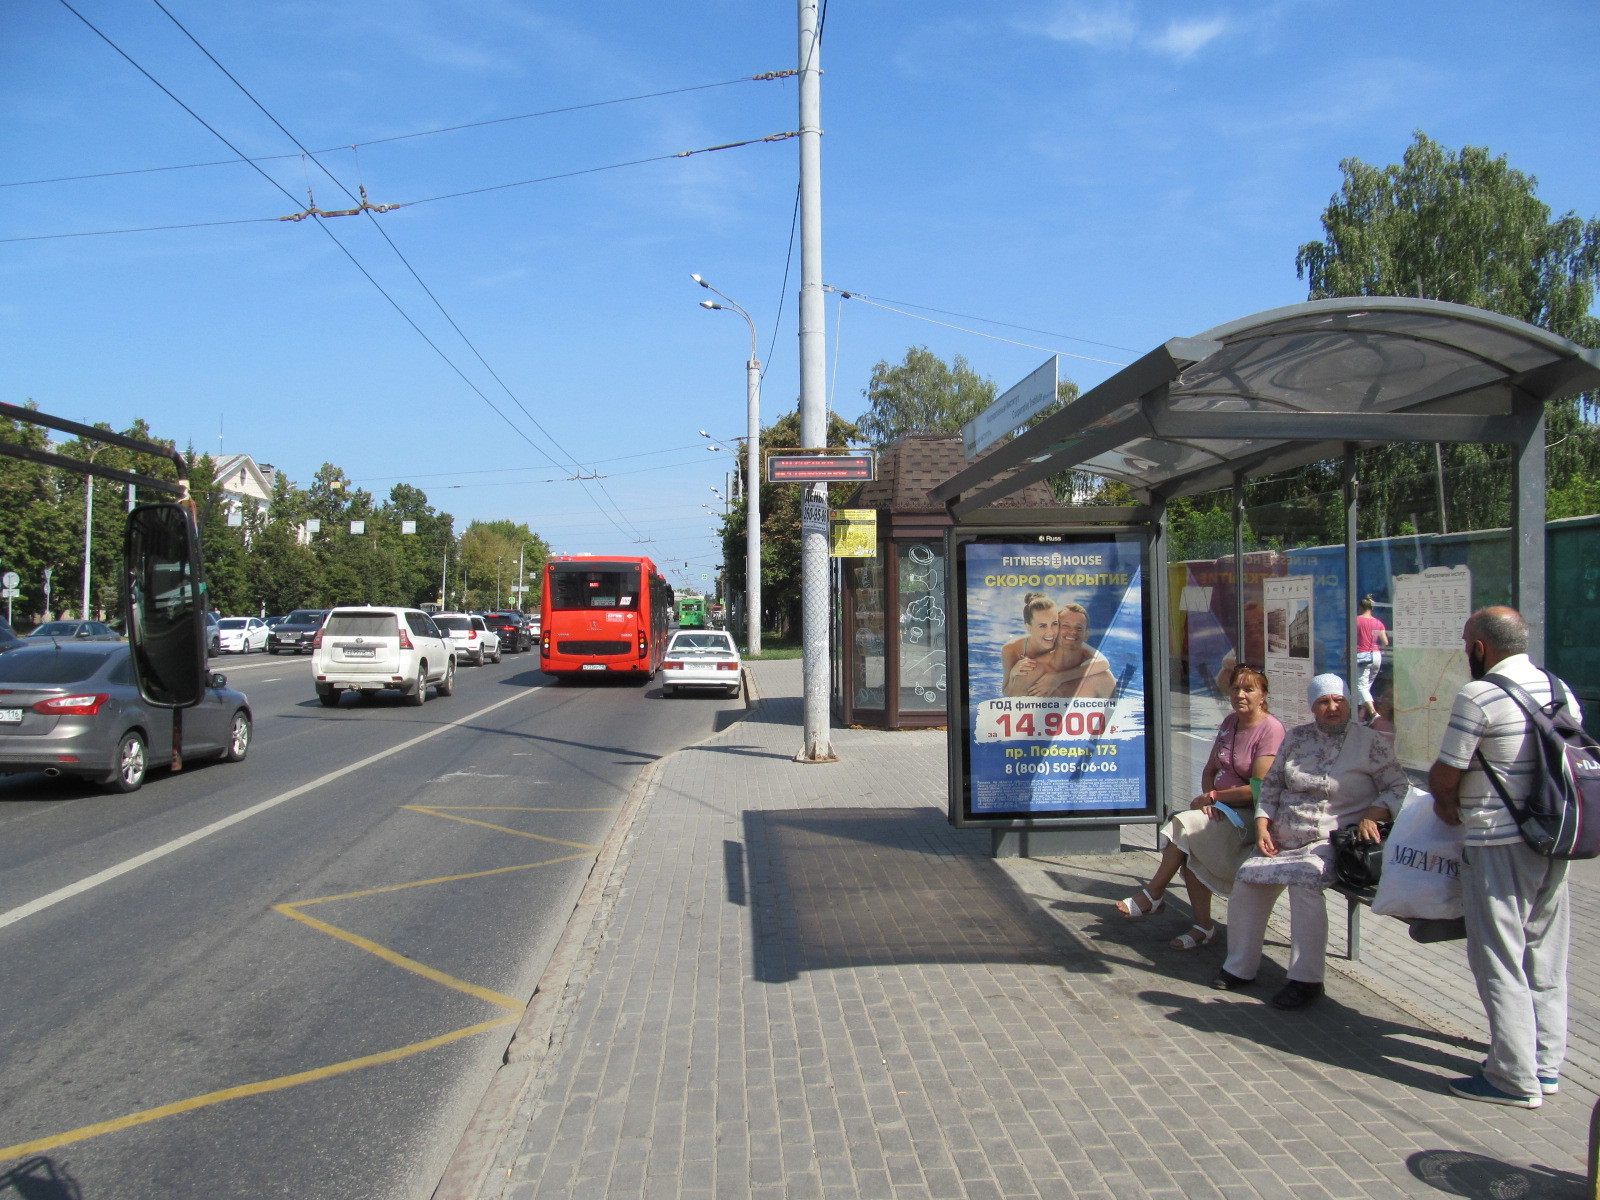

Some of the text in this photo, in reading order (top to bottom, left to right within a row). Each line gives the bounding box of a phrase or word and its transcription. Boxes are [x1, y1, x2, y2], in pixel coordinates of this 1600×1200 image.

[1003, 555, 1102, 566] FITNESS HOUSE
[985, 574, 1128, 587] СКОРО ОТКРЫТИЕ
[990, 701, 1012, 711] ГОД
[1015, 701, 1060, 711] фитнеса
[1073, 699, 1116, 708] бассейн
[996, 712, 1106, 737] 14.900
[1005, 744, 1118, 760] пр. Победы, 173
[1005, 761, 1118, 776] 8 (800) 505-06-06
